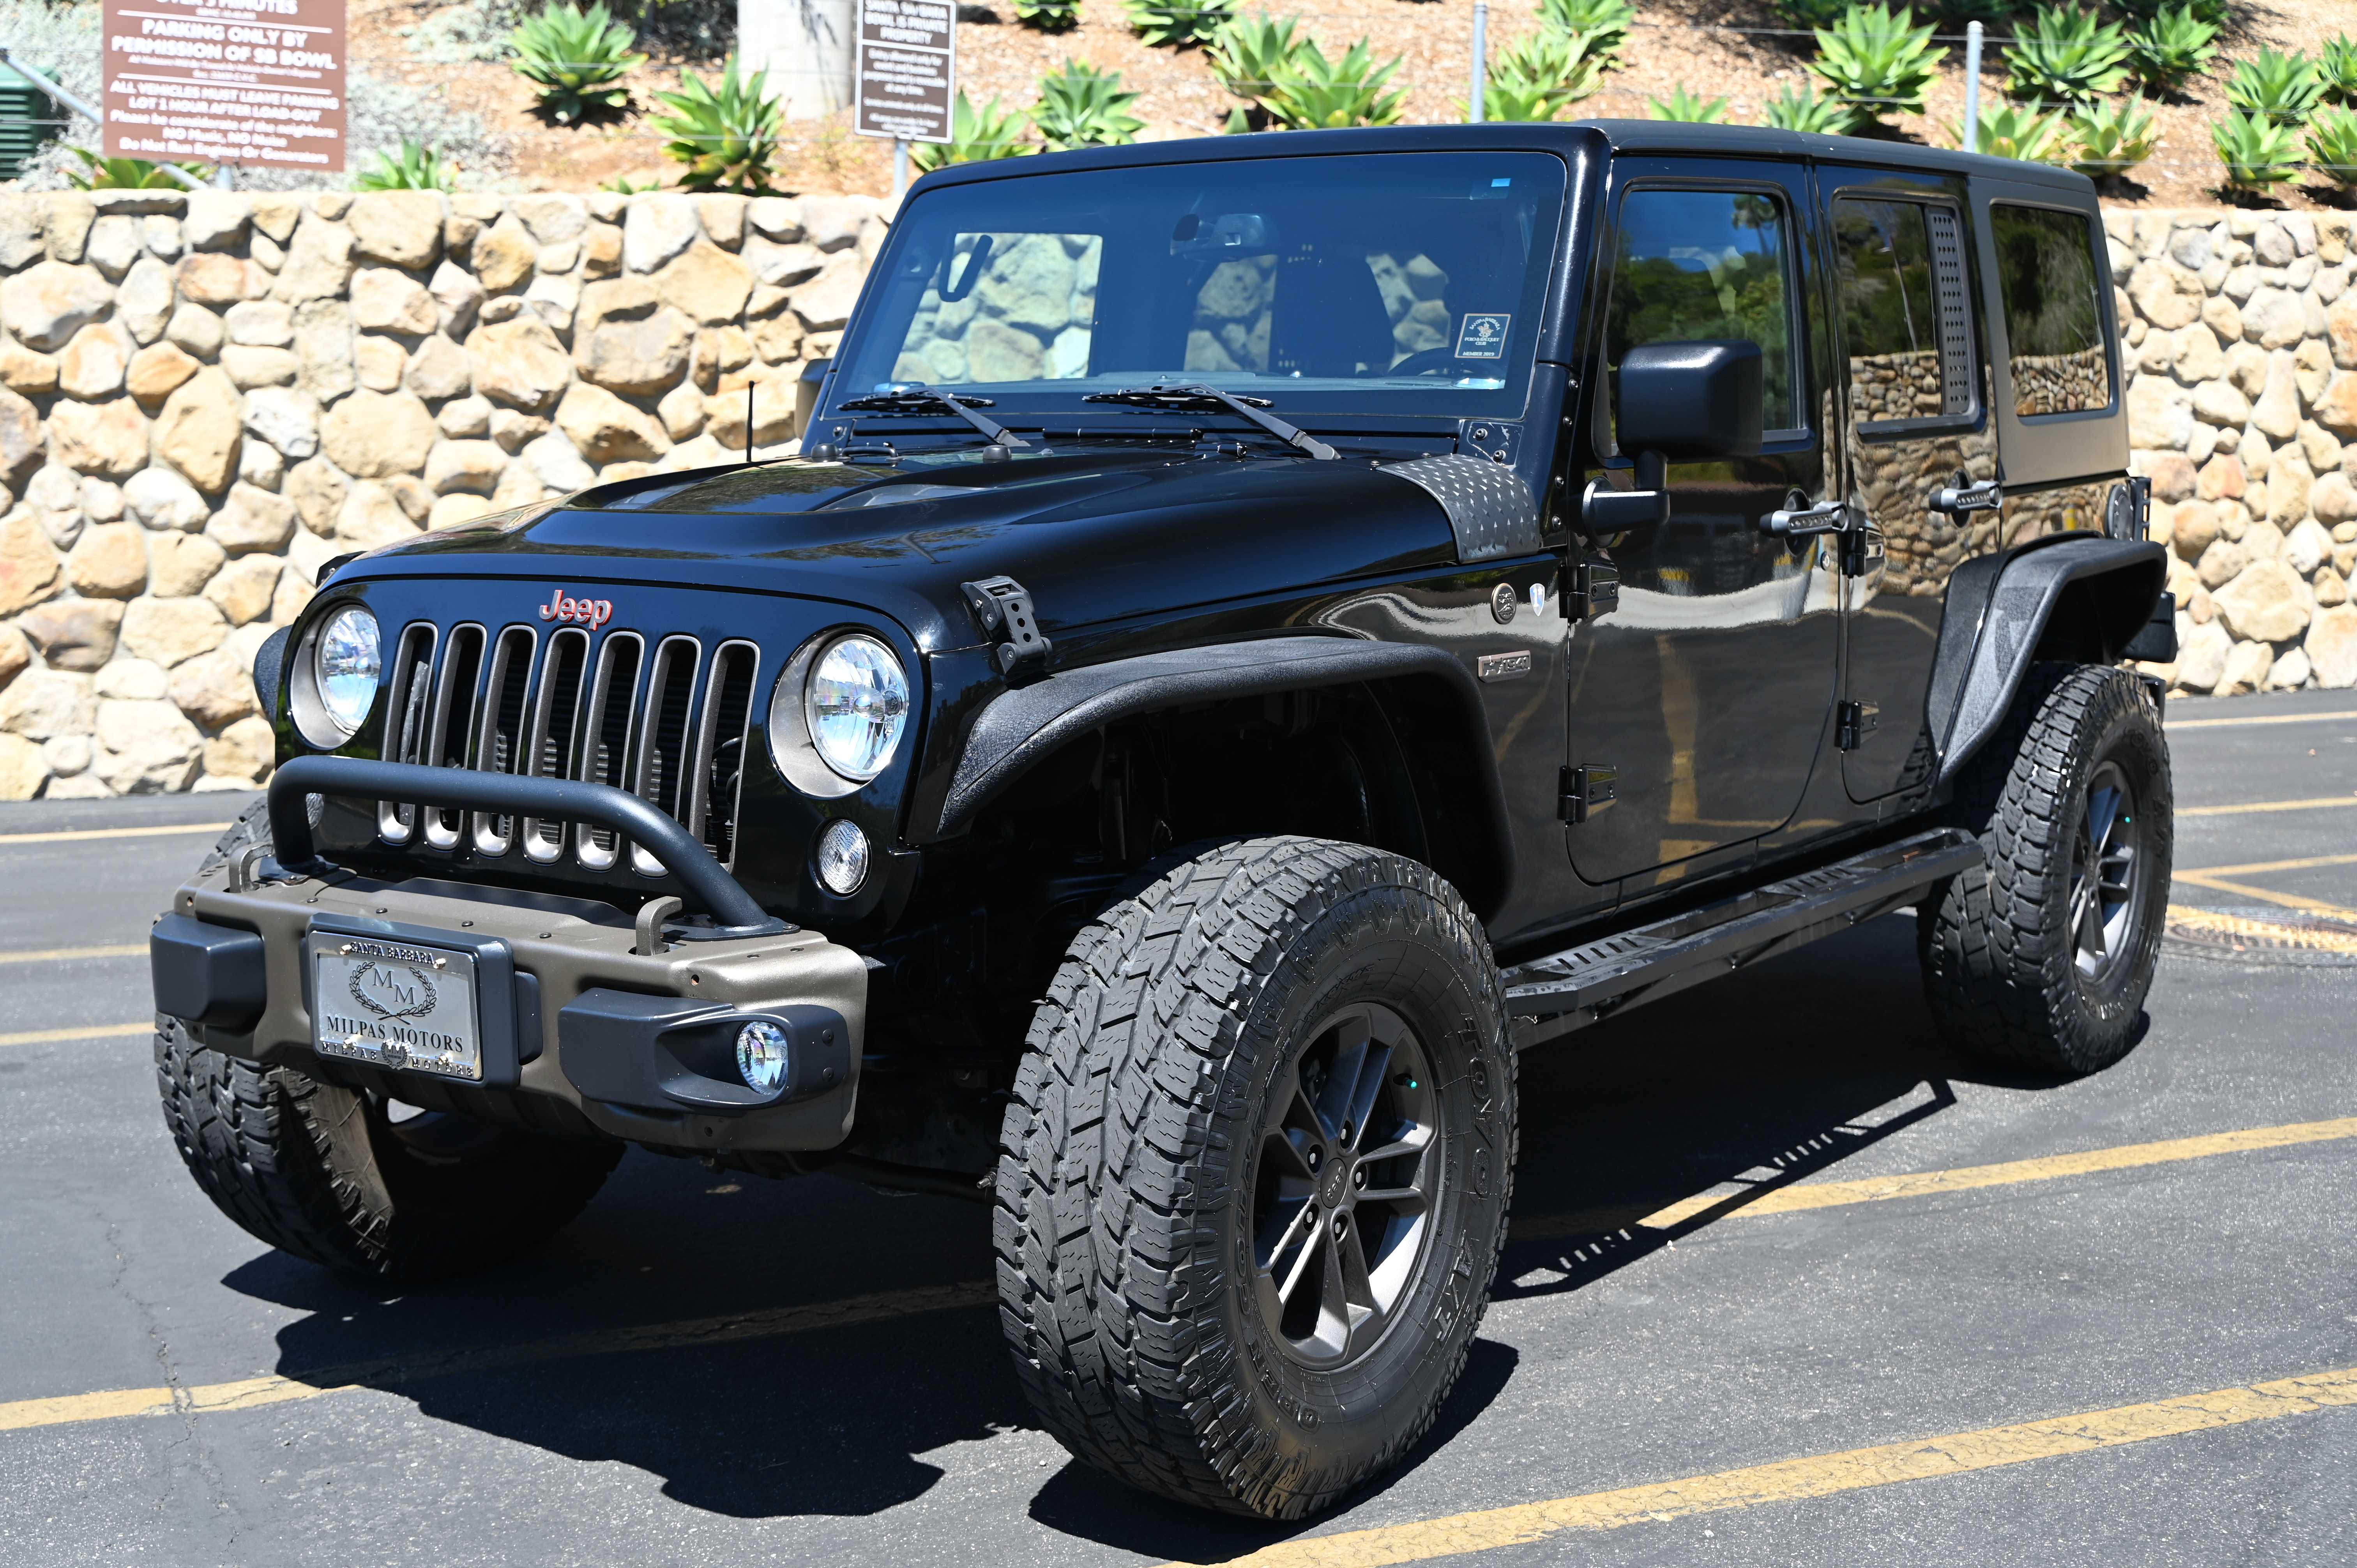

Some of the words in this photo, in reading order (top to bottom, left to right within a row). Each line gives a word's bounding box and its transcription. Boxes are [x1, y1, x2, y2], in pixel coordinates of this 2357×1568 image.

[142, 18, 225, 41] PARKING
[227, 26, 280, 46] ONLY
[282, 30, 308, 48] BY
[111, 35, 222, 59] PERMISSION
[224, 45, 252, 62] OF
[253, 47, 277, 64] SB
[279, 49, 337, 69] BOWL
[109, 80, 137, 94] ALL
[137, 82, 201, 99] VEHICLES
[201, 87, 239, 102] MUST
[239, 90, 281, 105] LEAVE
[281, 93, 339, 110] PARKING
[129, 95, 158, 109] LOT
[158, 97, 168, 111] 1
[168, 99, 209, 113] HOUR
[209, 102, 251, 117] AFTER
[110, 109, 150, 124] Please
[151, 112, 168, 125] be
[239, 119, 254, 131] of
[254, 120, 276, 133] the
[163, 126, 187, 140] NO
[227, 131, 251, 145] NO
[119, 136, 140, 150] Do
[140, 138, 166, 152] Not
[539, 589, 612, 632] Jeep
[350, 941, 384, 957] SANTA
[387, 947, 435, 965] BARBARA
[327, 1015, 385, 1039] MILPAS
[393, 1026, 463, 1053] MOTORS
[322, 1041, 377, 1060] MILPAS
[411, 1057, 474, 1077] MOTORS
[1458, 1017, 1493, 1195] TOYO
[1248, 1338, 1320, 1435] OPEN
